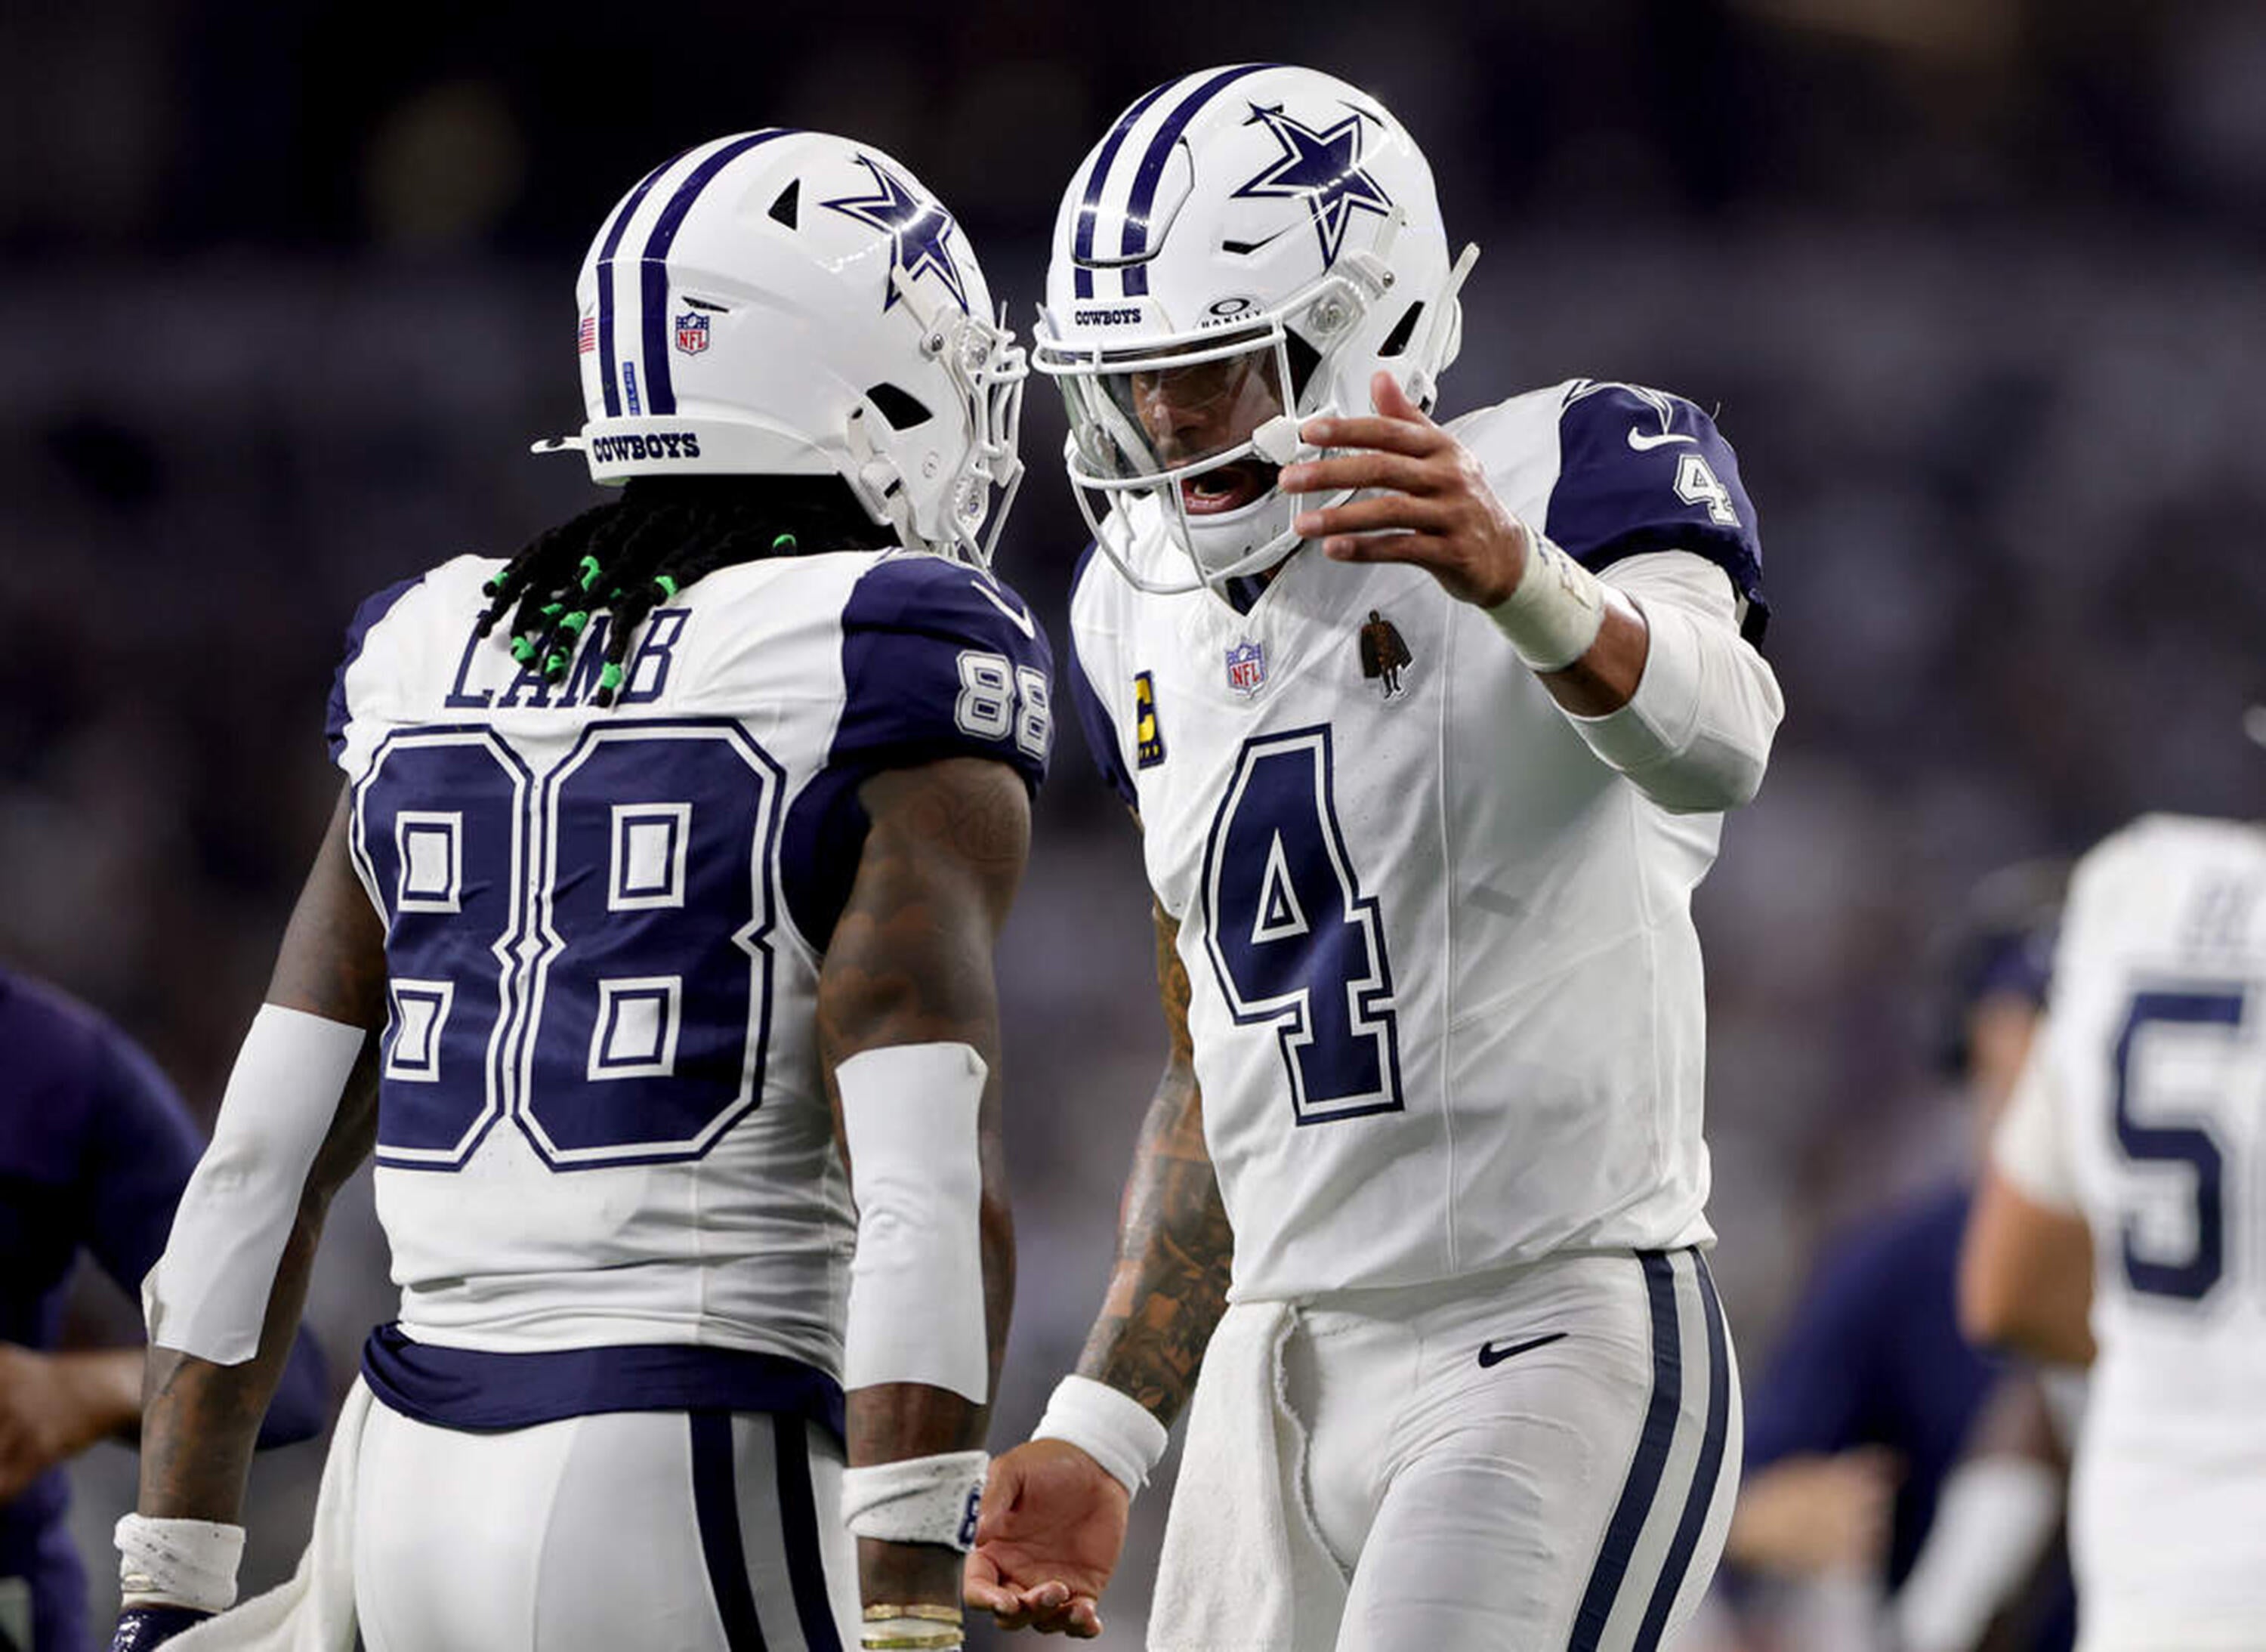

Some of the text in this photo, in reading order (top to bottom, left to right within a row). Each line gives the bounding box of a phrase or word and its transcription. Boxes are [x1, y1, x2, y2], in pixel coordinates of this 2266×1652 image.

[678, 330, 705, 351] NFL
[1075, 307, 1141, 326] COWBOYS
[593, 433, 700, 463] COWBOYS
[1672, 453, 1743, 528] 4
[1230, 662, 1261, 687] NFL
[954, 650, 1054, 761] 88
[350, 717, 787, 1172] 88
[1201, 722, 1406, 1127] 4
